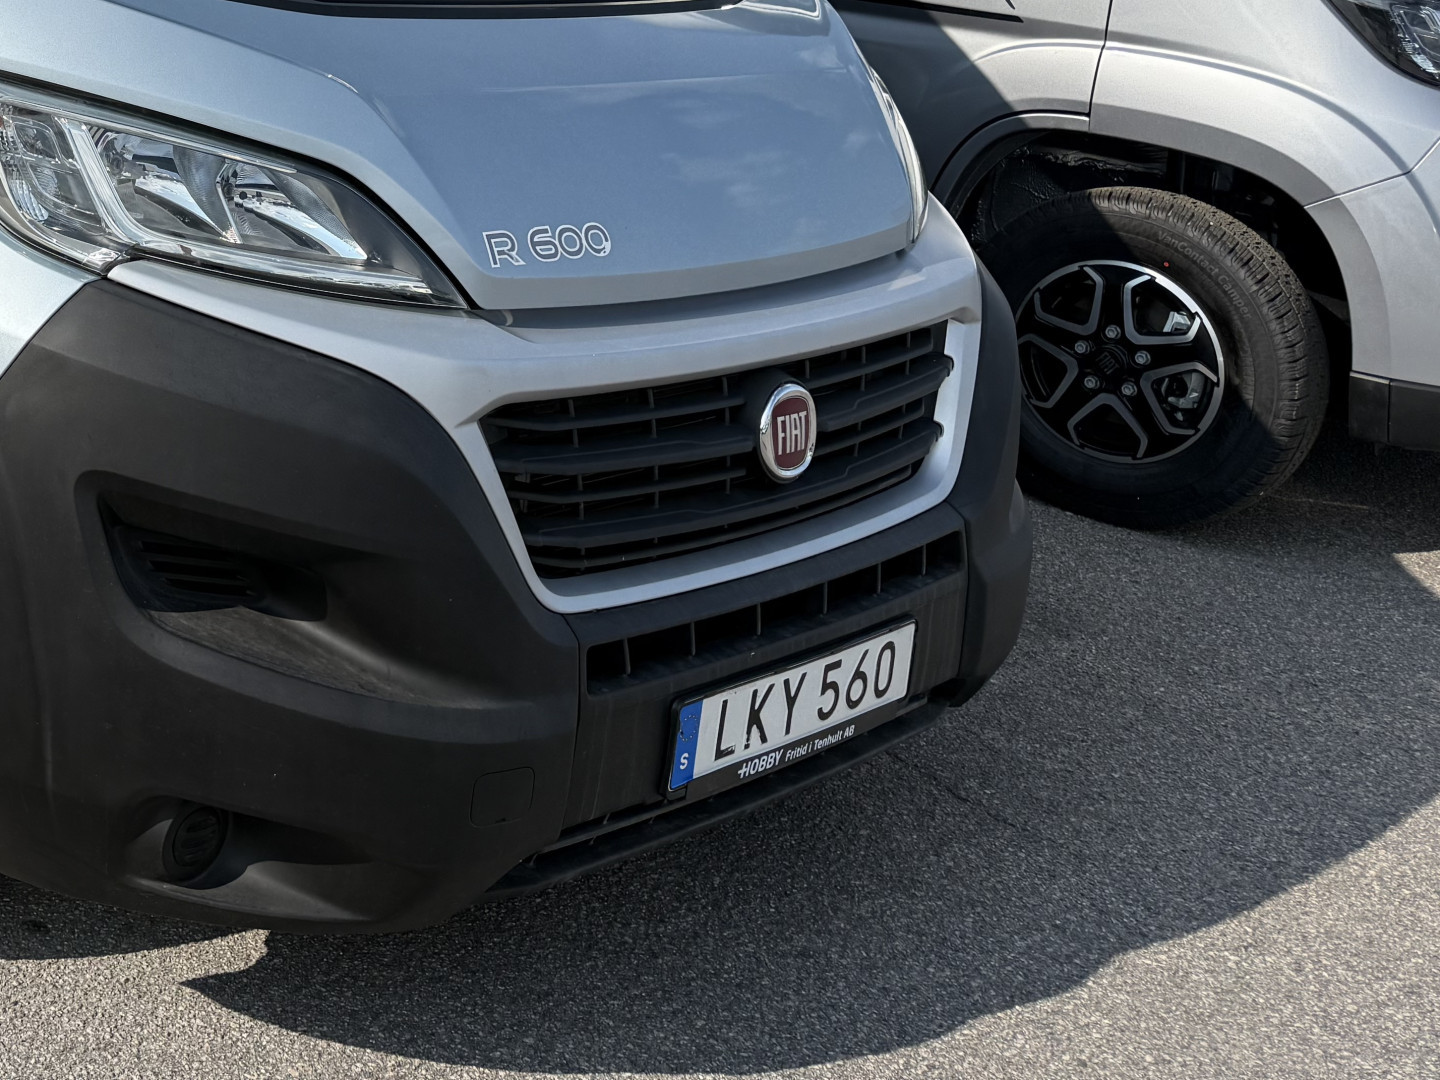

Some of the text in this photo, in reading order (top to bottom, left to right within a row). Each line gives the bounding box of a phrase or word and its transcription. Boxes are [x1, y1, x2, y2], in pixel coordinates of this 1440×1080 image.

[482, 222, 611, 268] R 600
[1158, 231, 1252, 319] VanContact Camper
[1095, 351, 1120, 375] FIAT
[776, 410, 808, 456] FIAT
[714, 640, 896, 762] LKY 560
[679, 752, 689, 771] S
[737, 749, 784, 779] HOBBY
[785, 742, 808, 762] Fritid
[814, 729, 843, 750] Tenhult
[843, 724, 856, 739] AB
